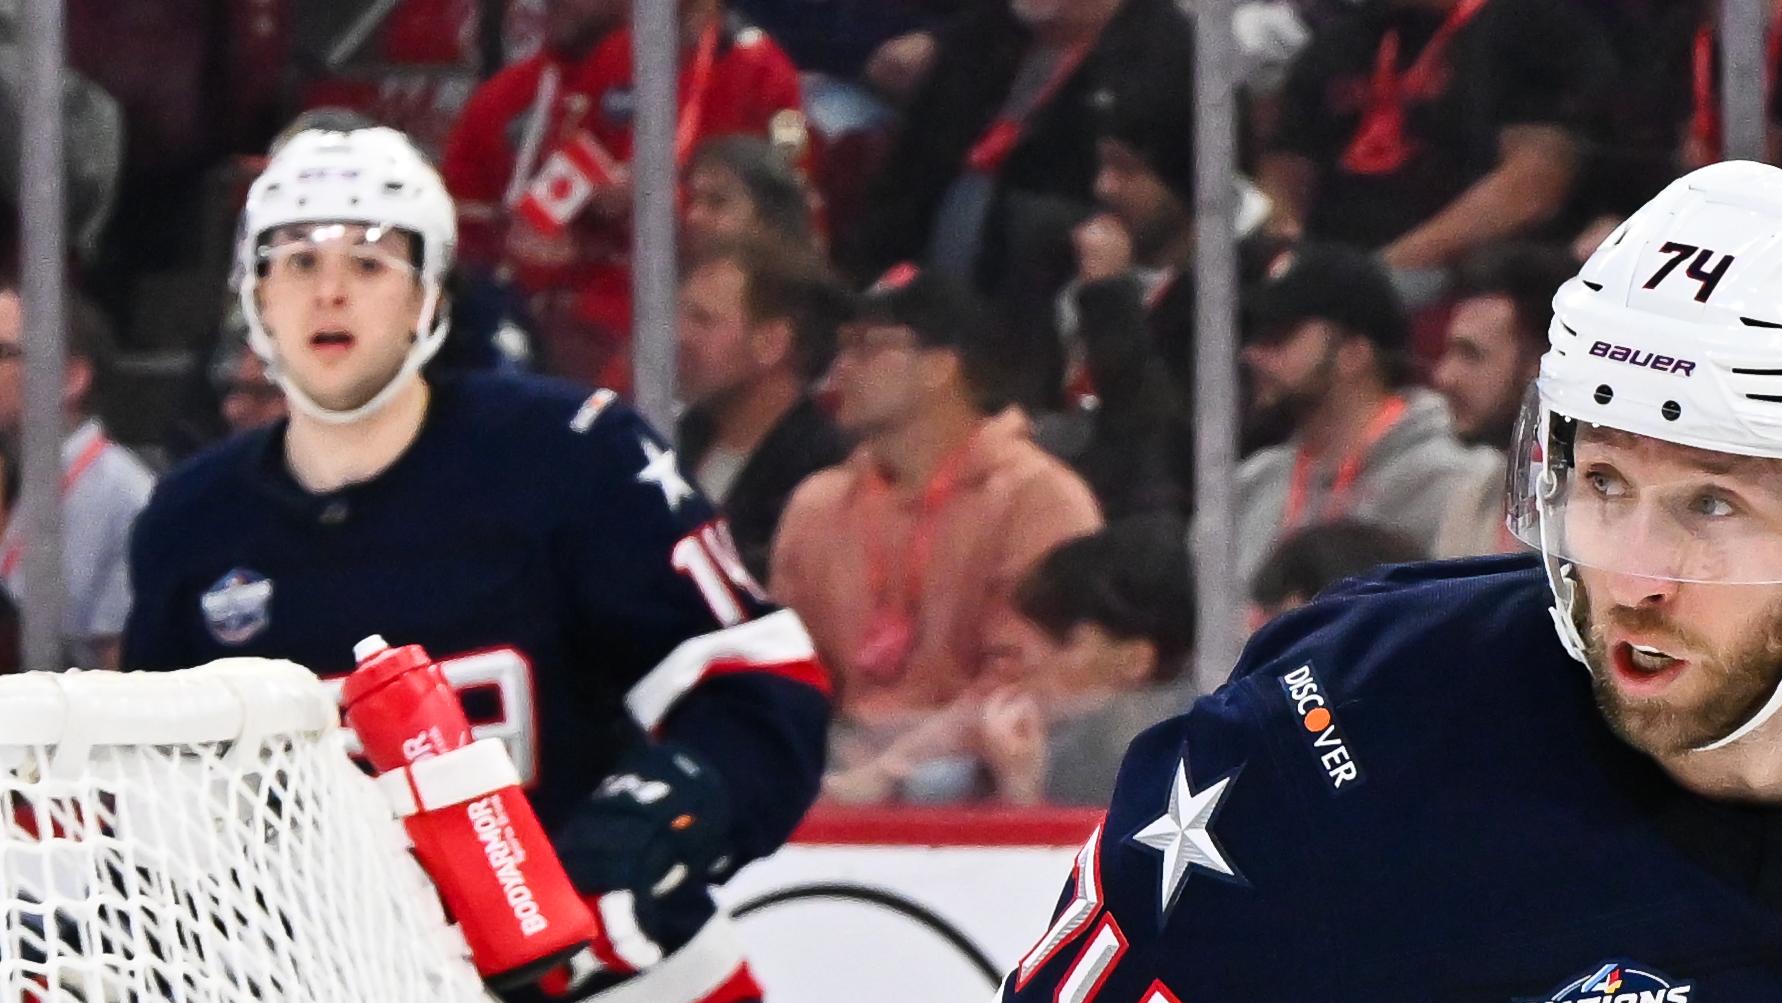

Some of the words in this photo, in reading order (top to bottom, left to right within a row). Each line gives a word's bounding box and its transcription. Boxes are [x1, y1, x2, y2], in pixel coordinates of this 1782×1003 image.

[1642, 241, 1735, 303] 74
[1283, 665, 1358, 789] DISCOVER
[467, 797, 548, 938] BODYARMOR
